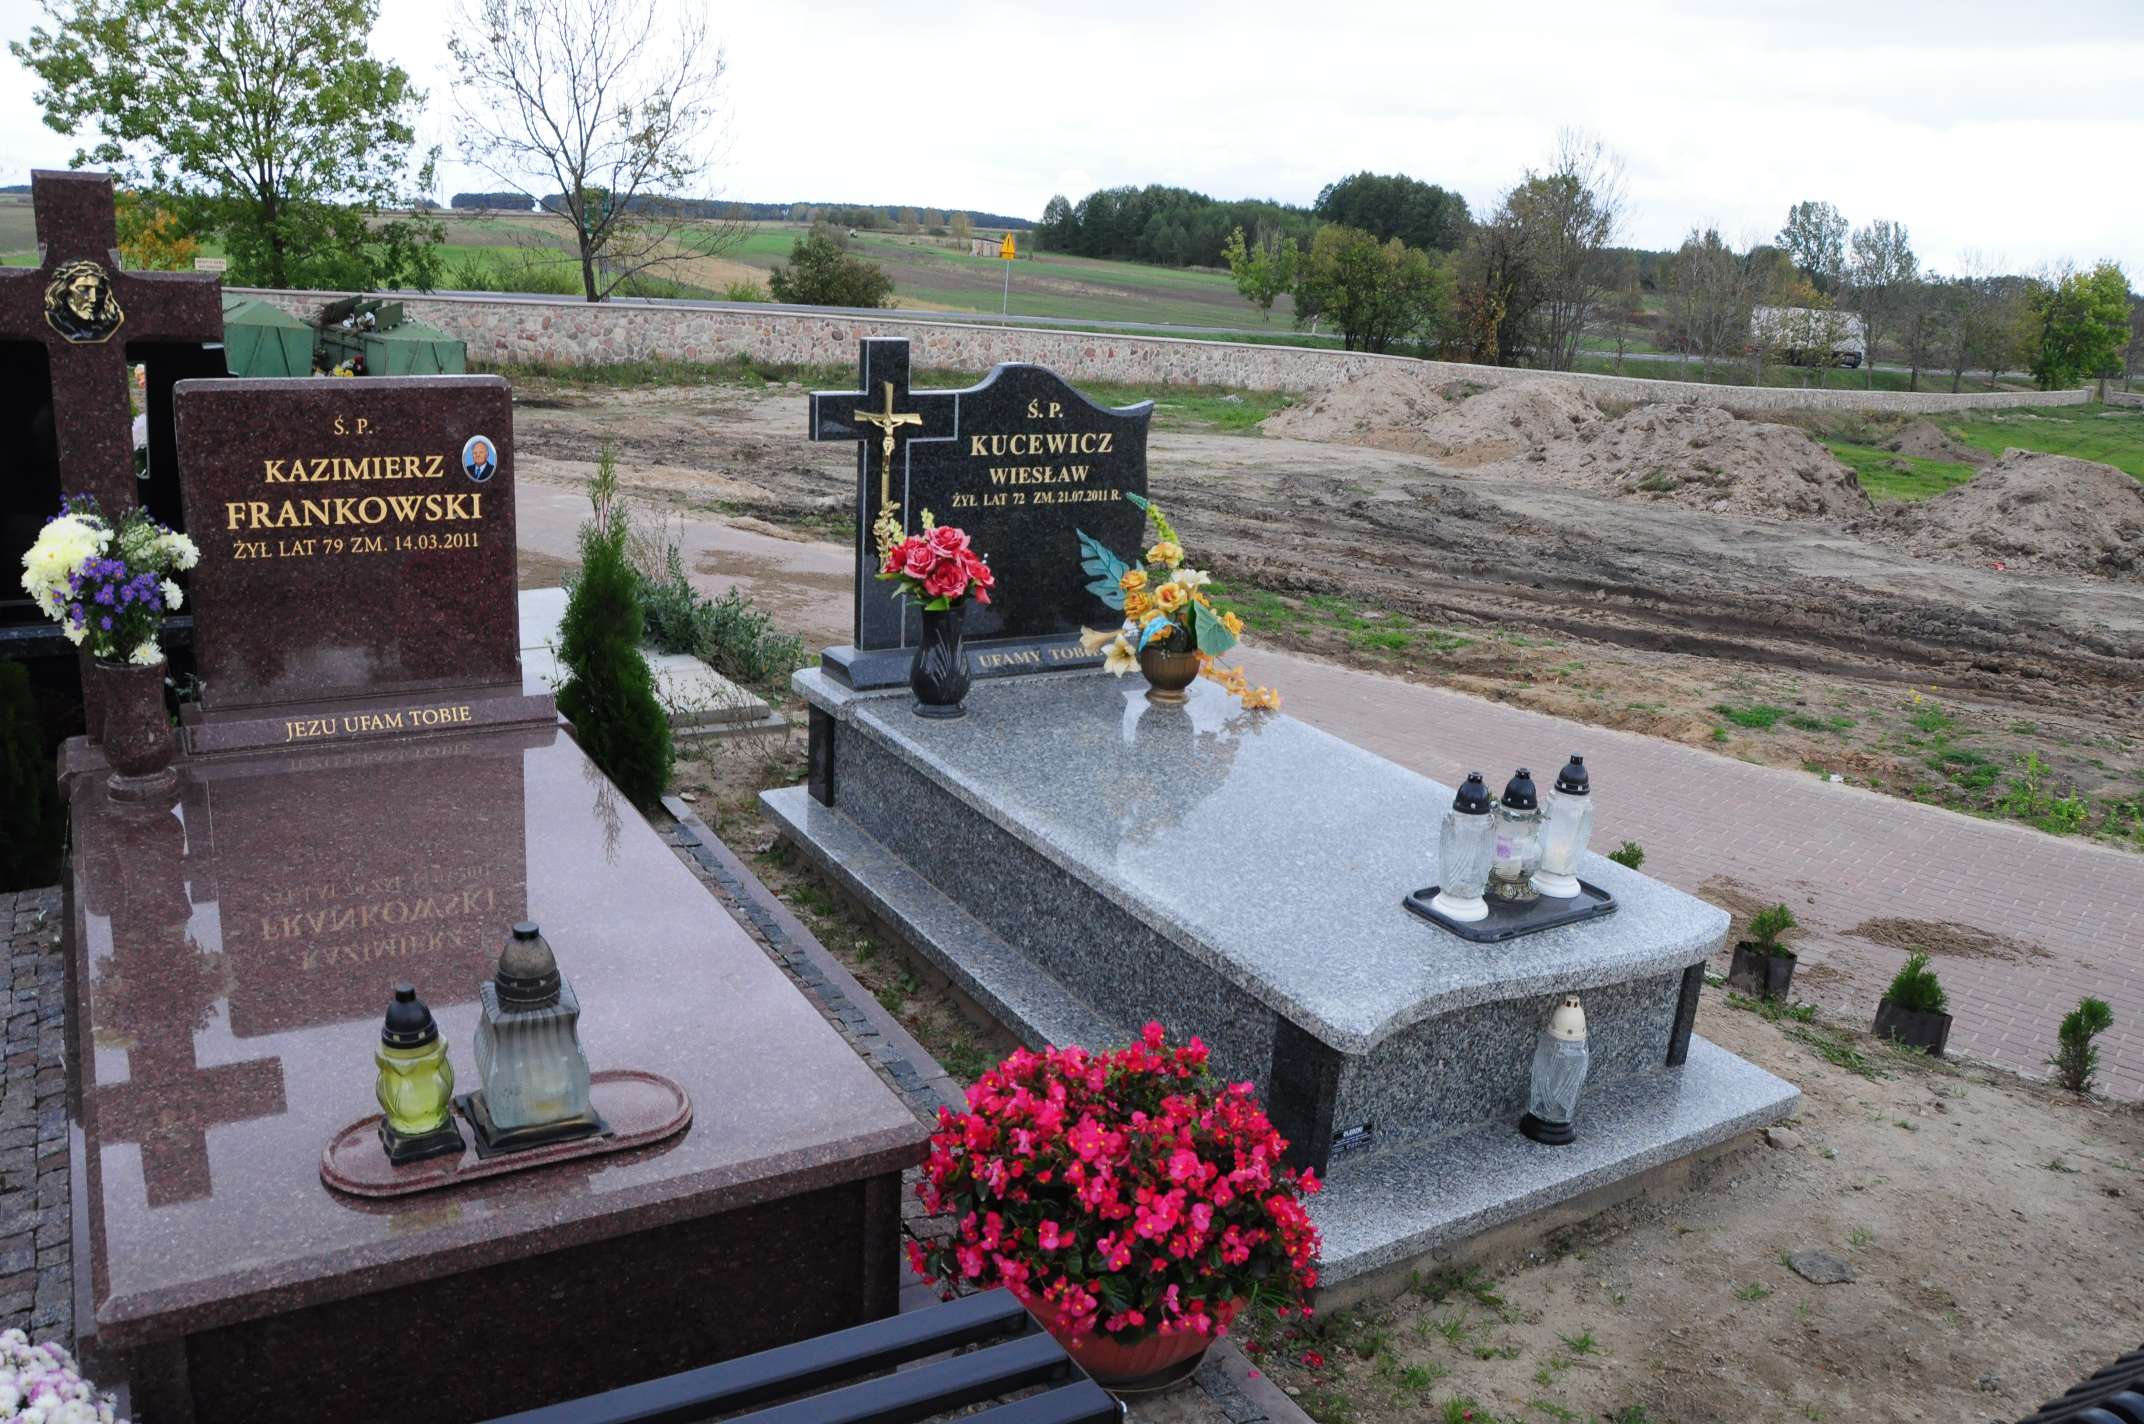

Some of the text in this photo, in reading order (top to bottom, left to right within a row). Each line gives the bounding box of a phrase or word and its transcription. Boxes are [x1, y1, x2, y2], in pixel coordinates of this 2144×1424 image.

[1027, 398, 1064, 419] Ś. P.
[334, 414, 373, 435] Ś. P.
[970, 432, 1113, 456] KUCEWICZ
[263, 455, 444, 483] KAZIMIERZ
[989, 465, 1090, 485] WIESŁAW
[983, 493, 1008, 506] LAT
[1012, 492, 1025, 505] 72
[1033, 491, 1055, 504] ZM.
[1057, 489, 1108, 503] 21.07.2011
[1110, 488, 1122, 501] R.
[225, 493, 482, 530] FRANKOWSKI
[233, 532, 479, 559] ŻYŁ LAT 79 ZM. 14.03.2011
[978, 650, 1041, 668] UFAMY
[286, 706, 472, 742] JEZU UFAM TOBIE
